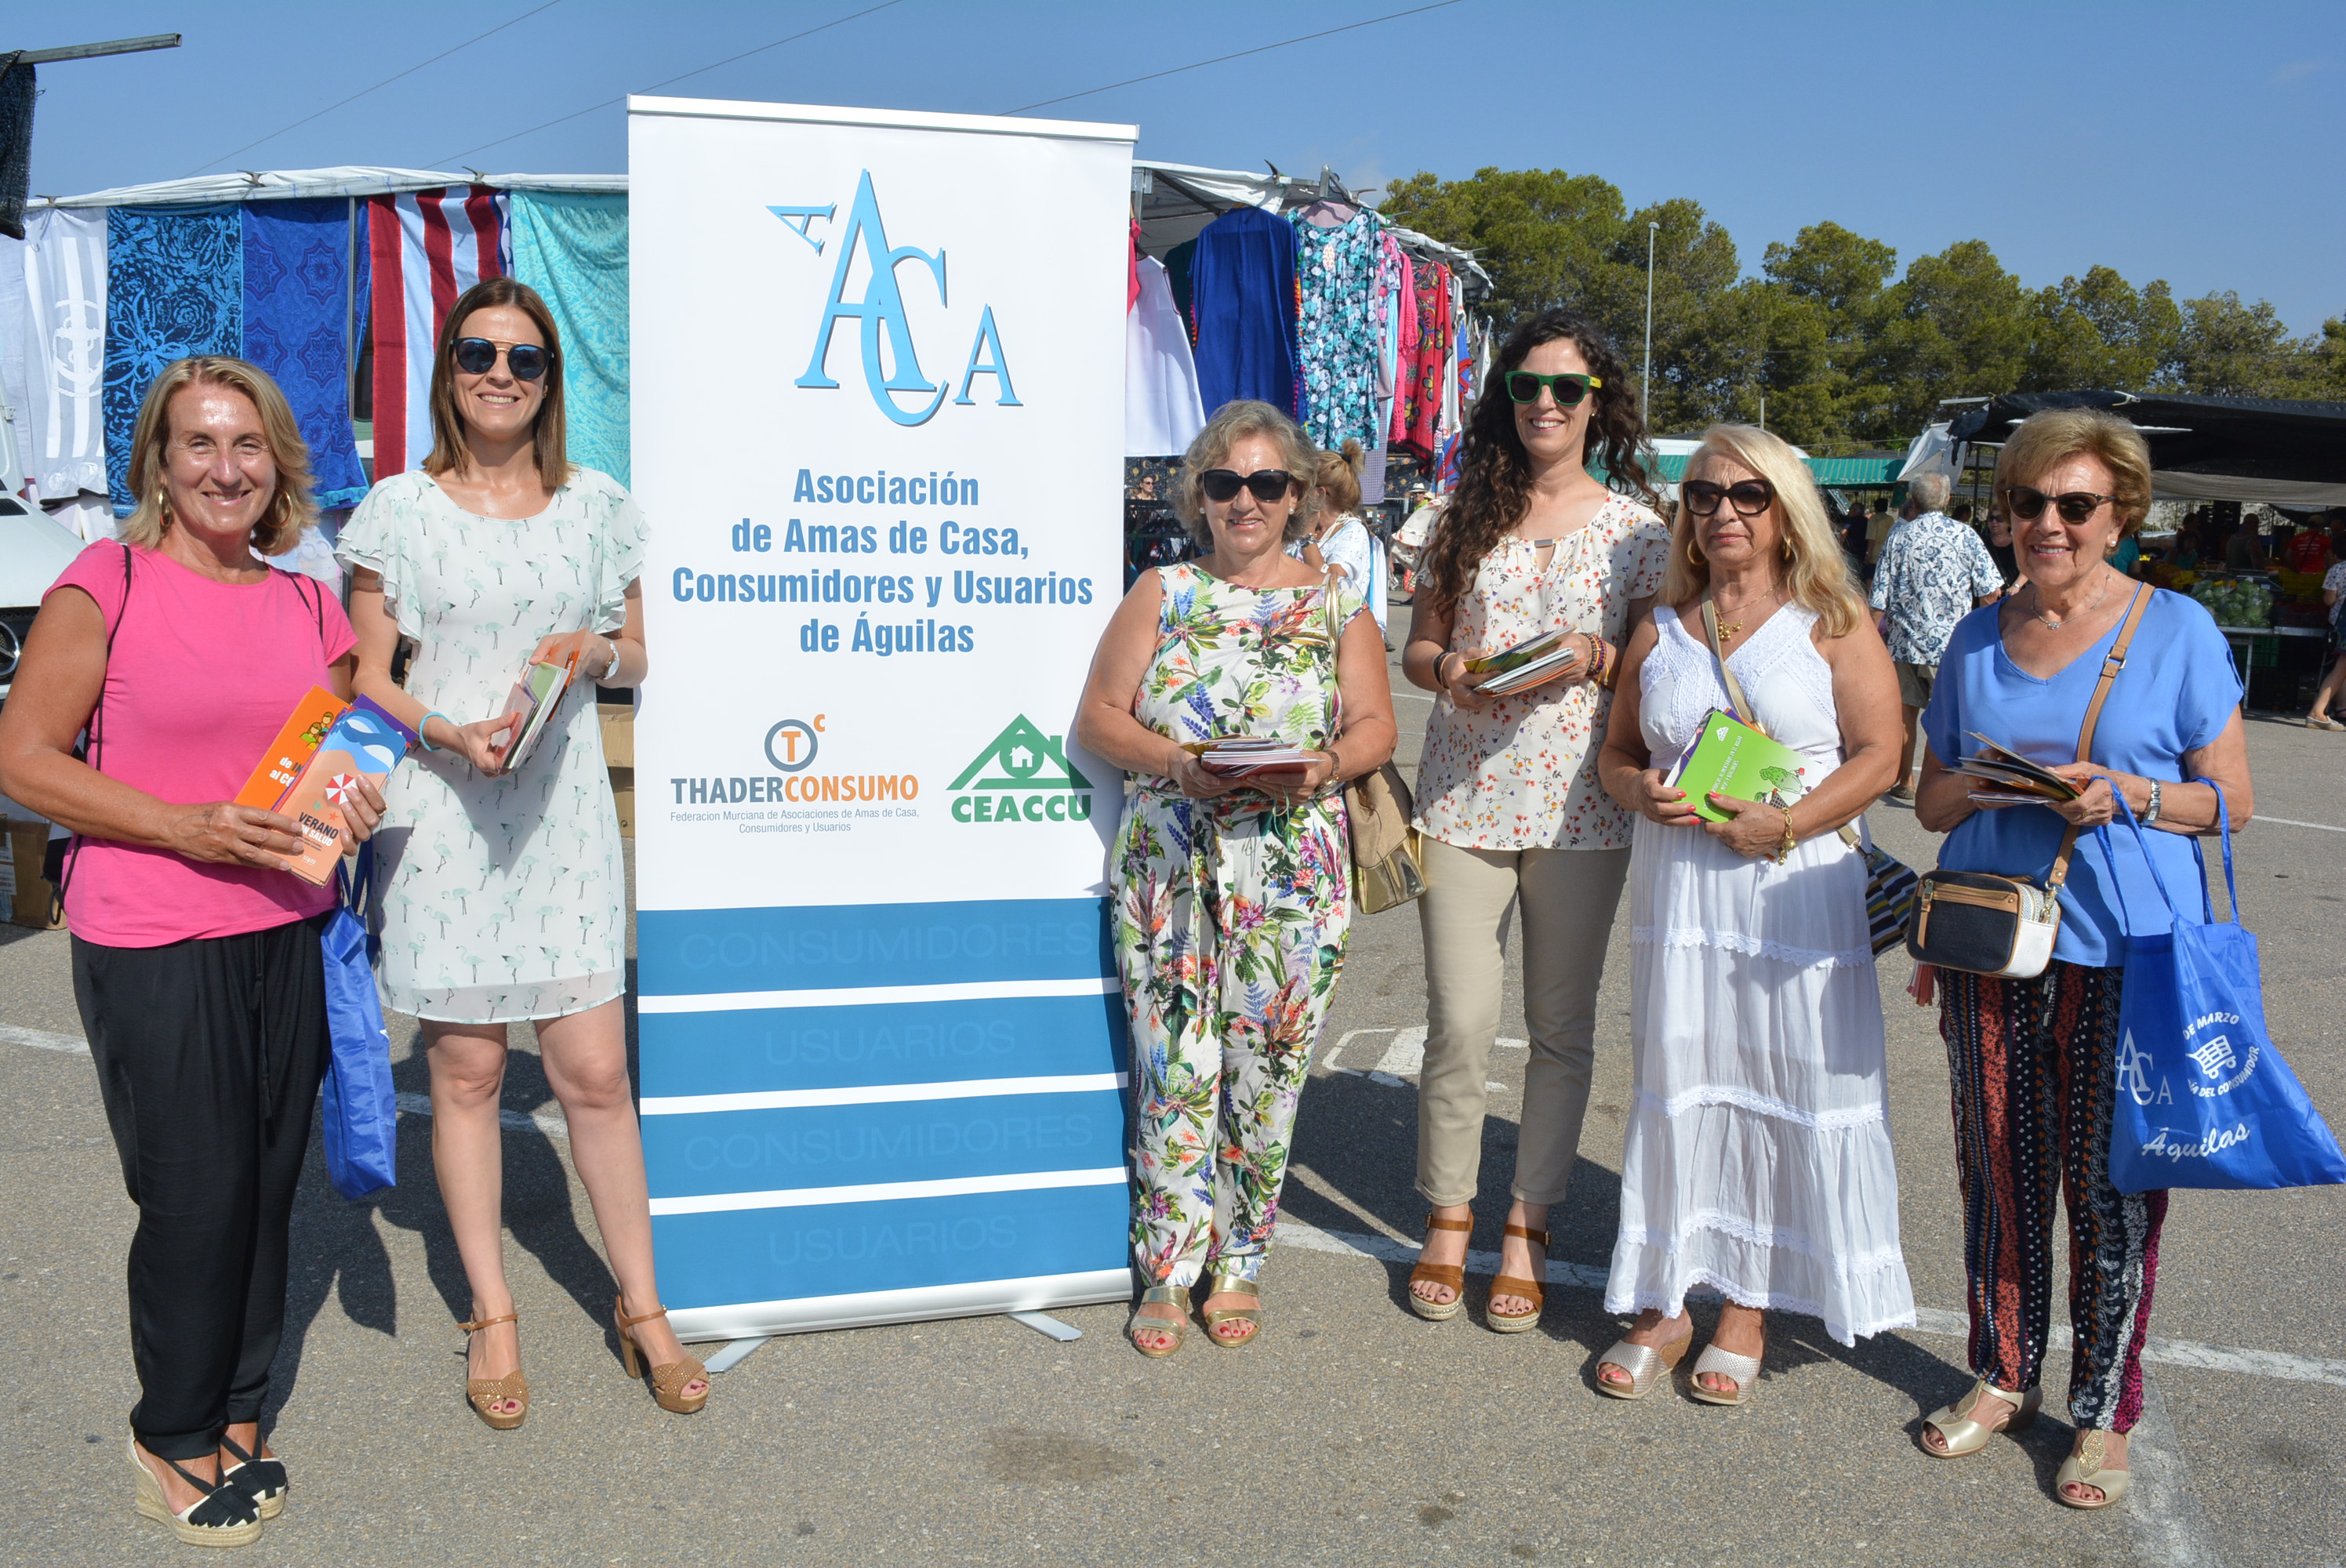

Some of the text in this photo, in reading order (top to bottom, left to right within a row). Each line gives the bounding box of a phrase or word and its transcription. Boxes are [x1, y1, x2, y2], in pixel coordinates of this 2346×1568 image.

[793, 468, 979, 506] Asociación
[732, 517, 1029, 560] de Amas de Casa,
[672, 567, 1093, 608] Consumidores y Usuarios
[800, 611, 975, 657] de Águilas
[269, 769, 281, 781] al
[279, 757, 292, 769] de
[670, 774, 919, 804] THADERCONSUMO
[298, 811, 340, 840] VERANO
[670, 808, 920, 822] Federacion Murciana de Asociaciones de Amas de Casa,
[951, 794, 1091, 823] CEACCU
[308, 829, 334, 847] SALUD
[739, 822, 852, 834] Consumidores y Usuarios
[680, 920, 1093, 970] CONSUMIDORES
[764, 1019, 1017, 1065] USUARIOS
[2182, 1011, 2240, 1040] DE MARZO
[2199, 1087, 2216, 1098] DEL
[2217, 1046, 2260, 1096] CONSUMIDOR
[684, 1114, 1094, 1172] CONSUMIDORES
[2141, 1123, 2250, 1163] Águilas
[769, 1214, 1018, 1265] USUARIOS
